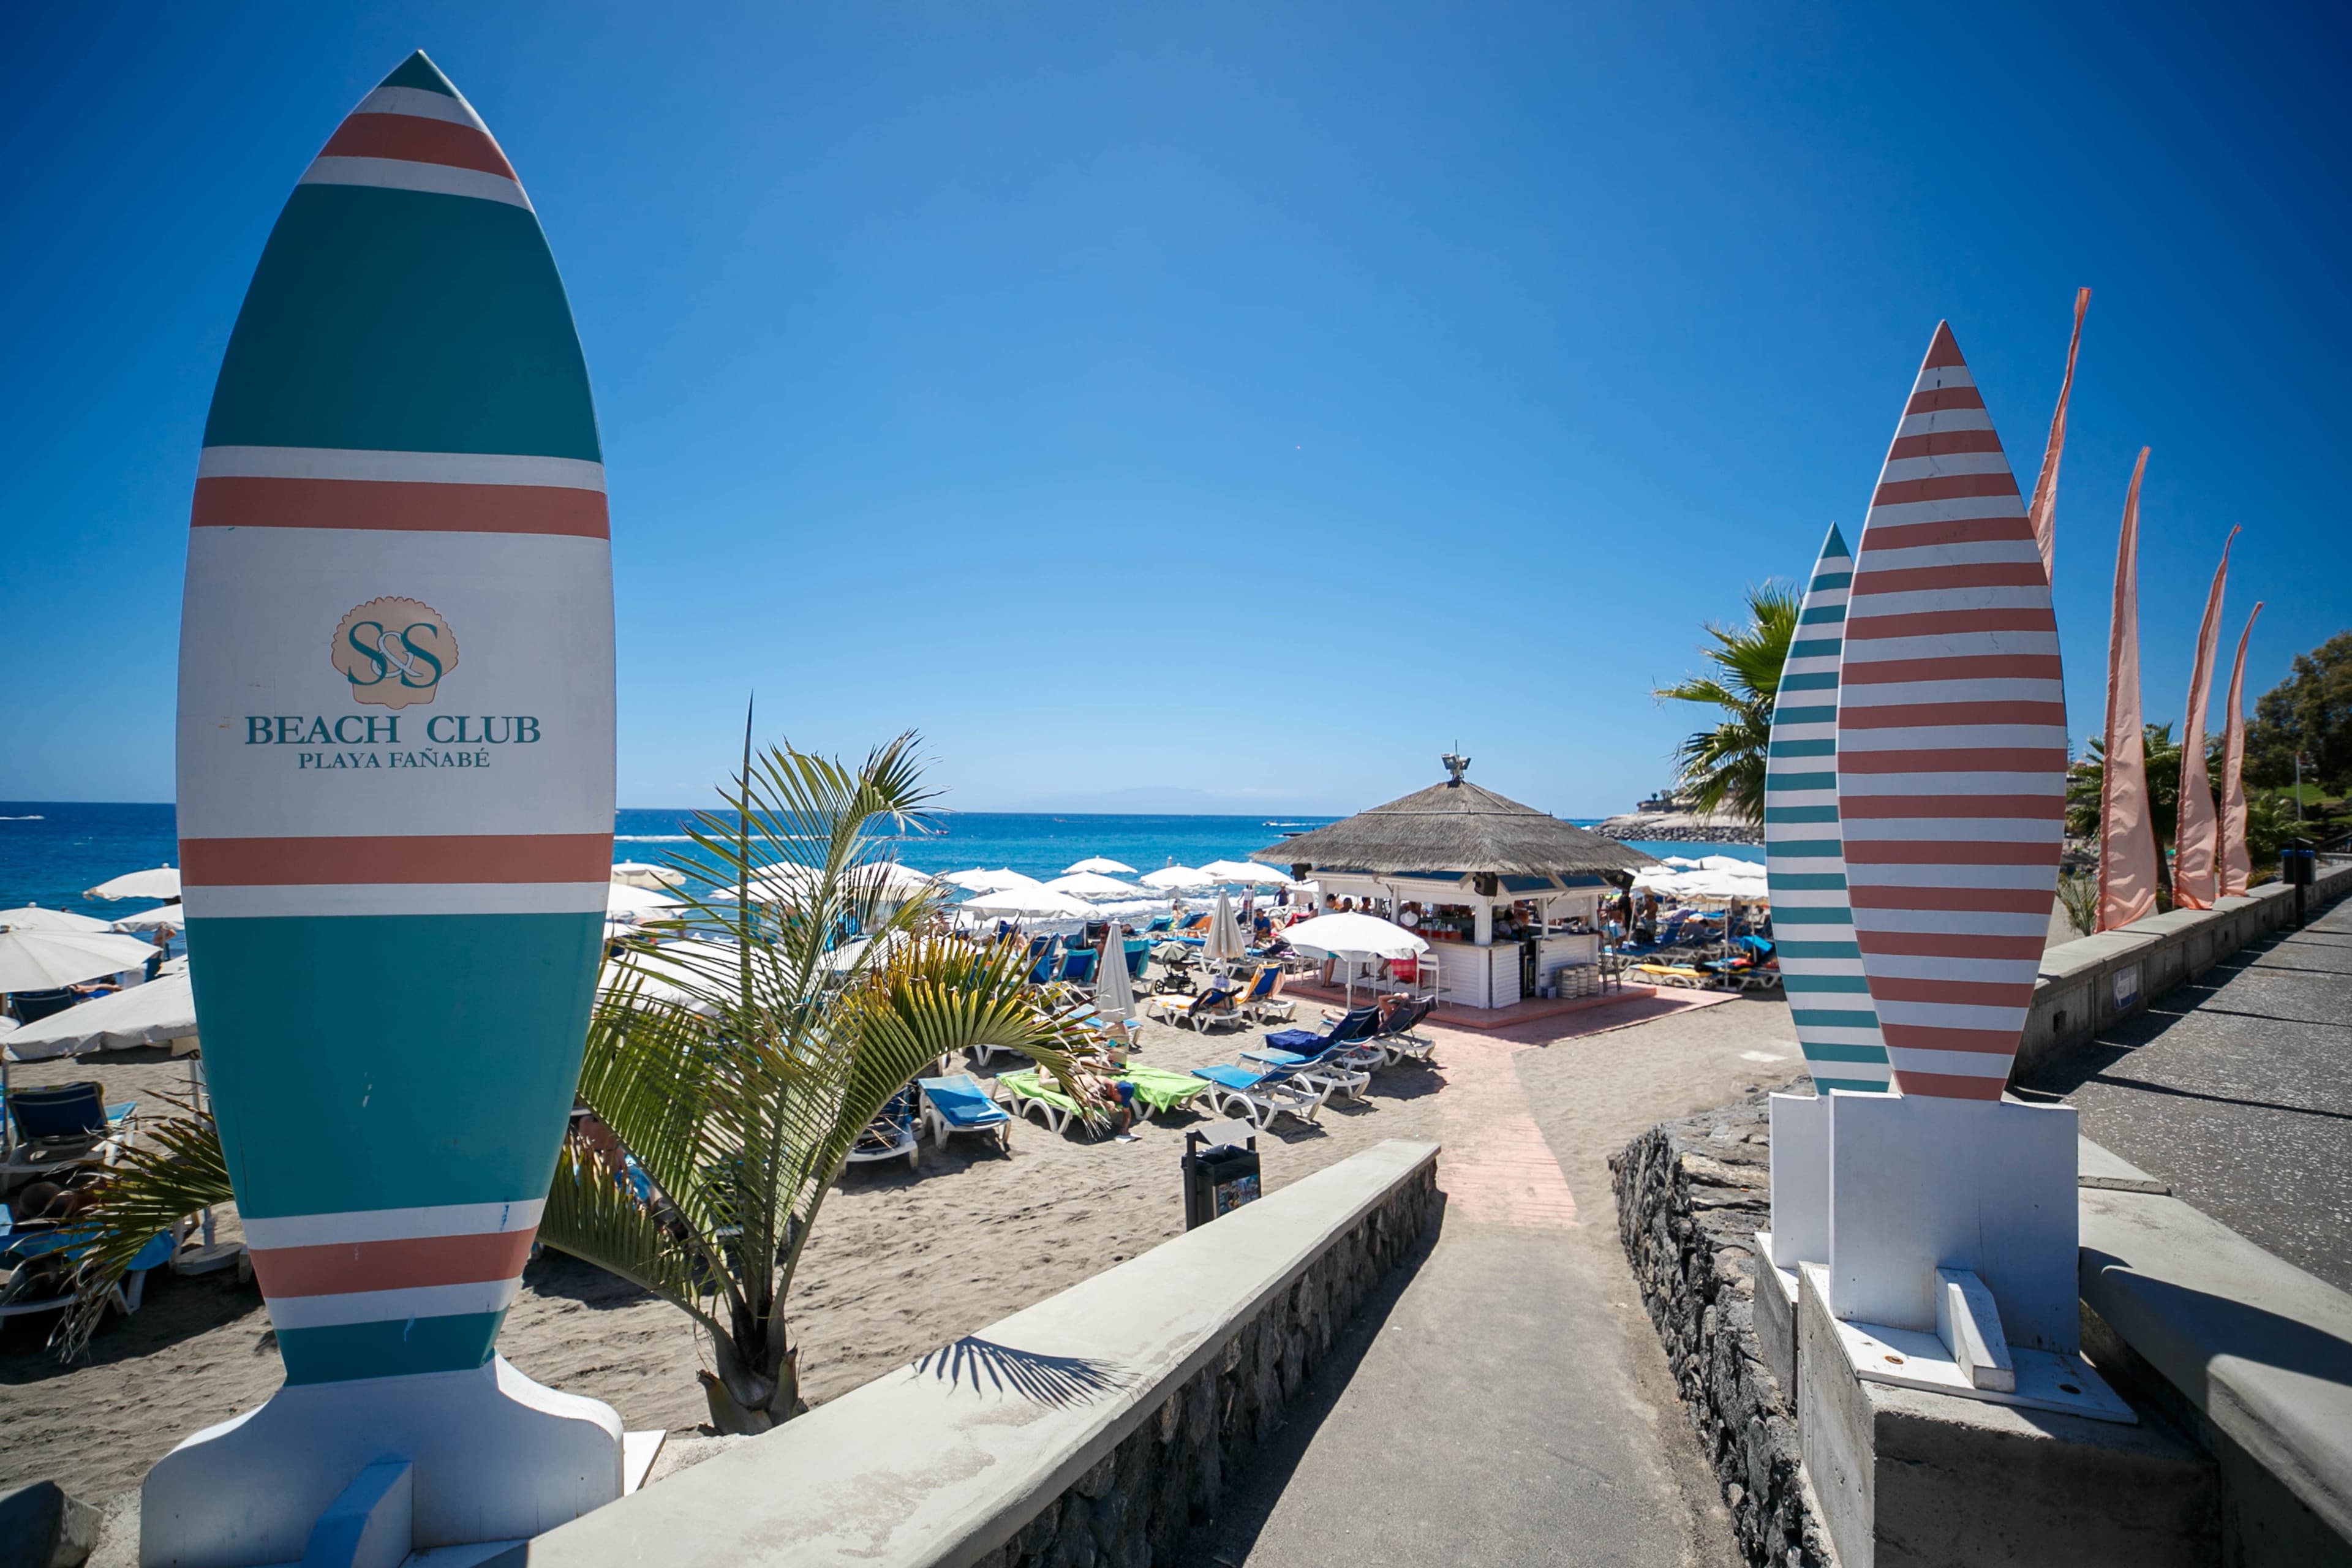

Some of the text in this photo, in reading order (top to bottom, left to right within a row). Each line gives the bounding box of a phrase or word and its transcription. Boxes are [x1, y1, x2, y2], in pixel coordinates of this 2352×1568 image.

[244, 715, 541, 745] BEACH CLUB
[298, 747, 490, 769] PLAYA FAÑABÉ
